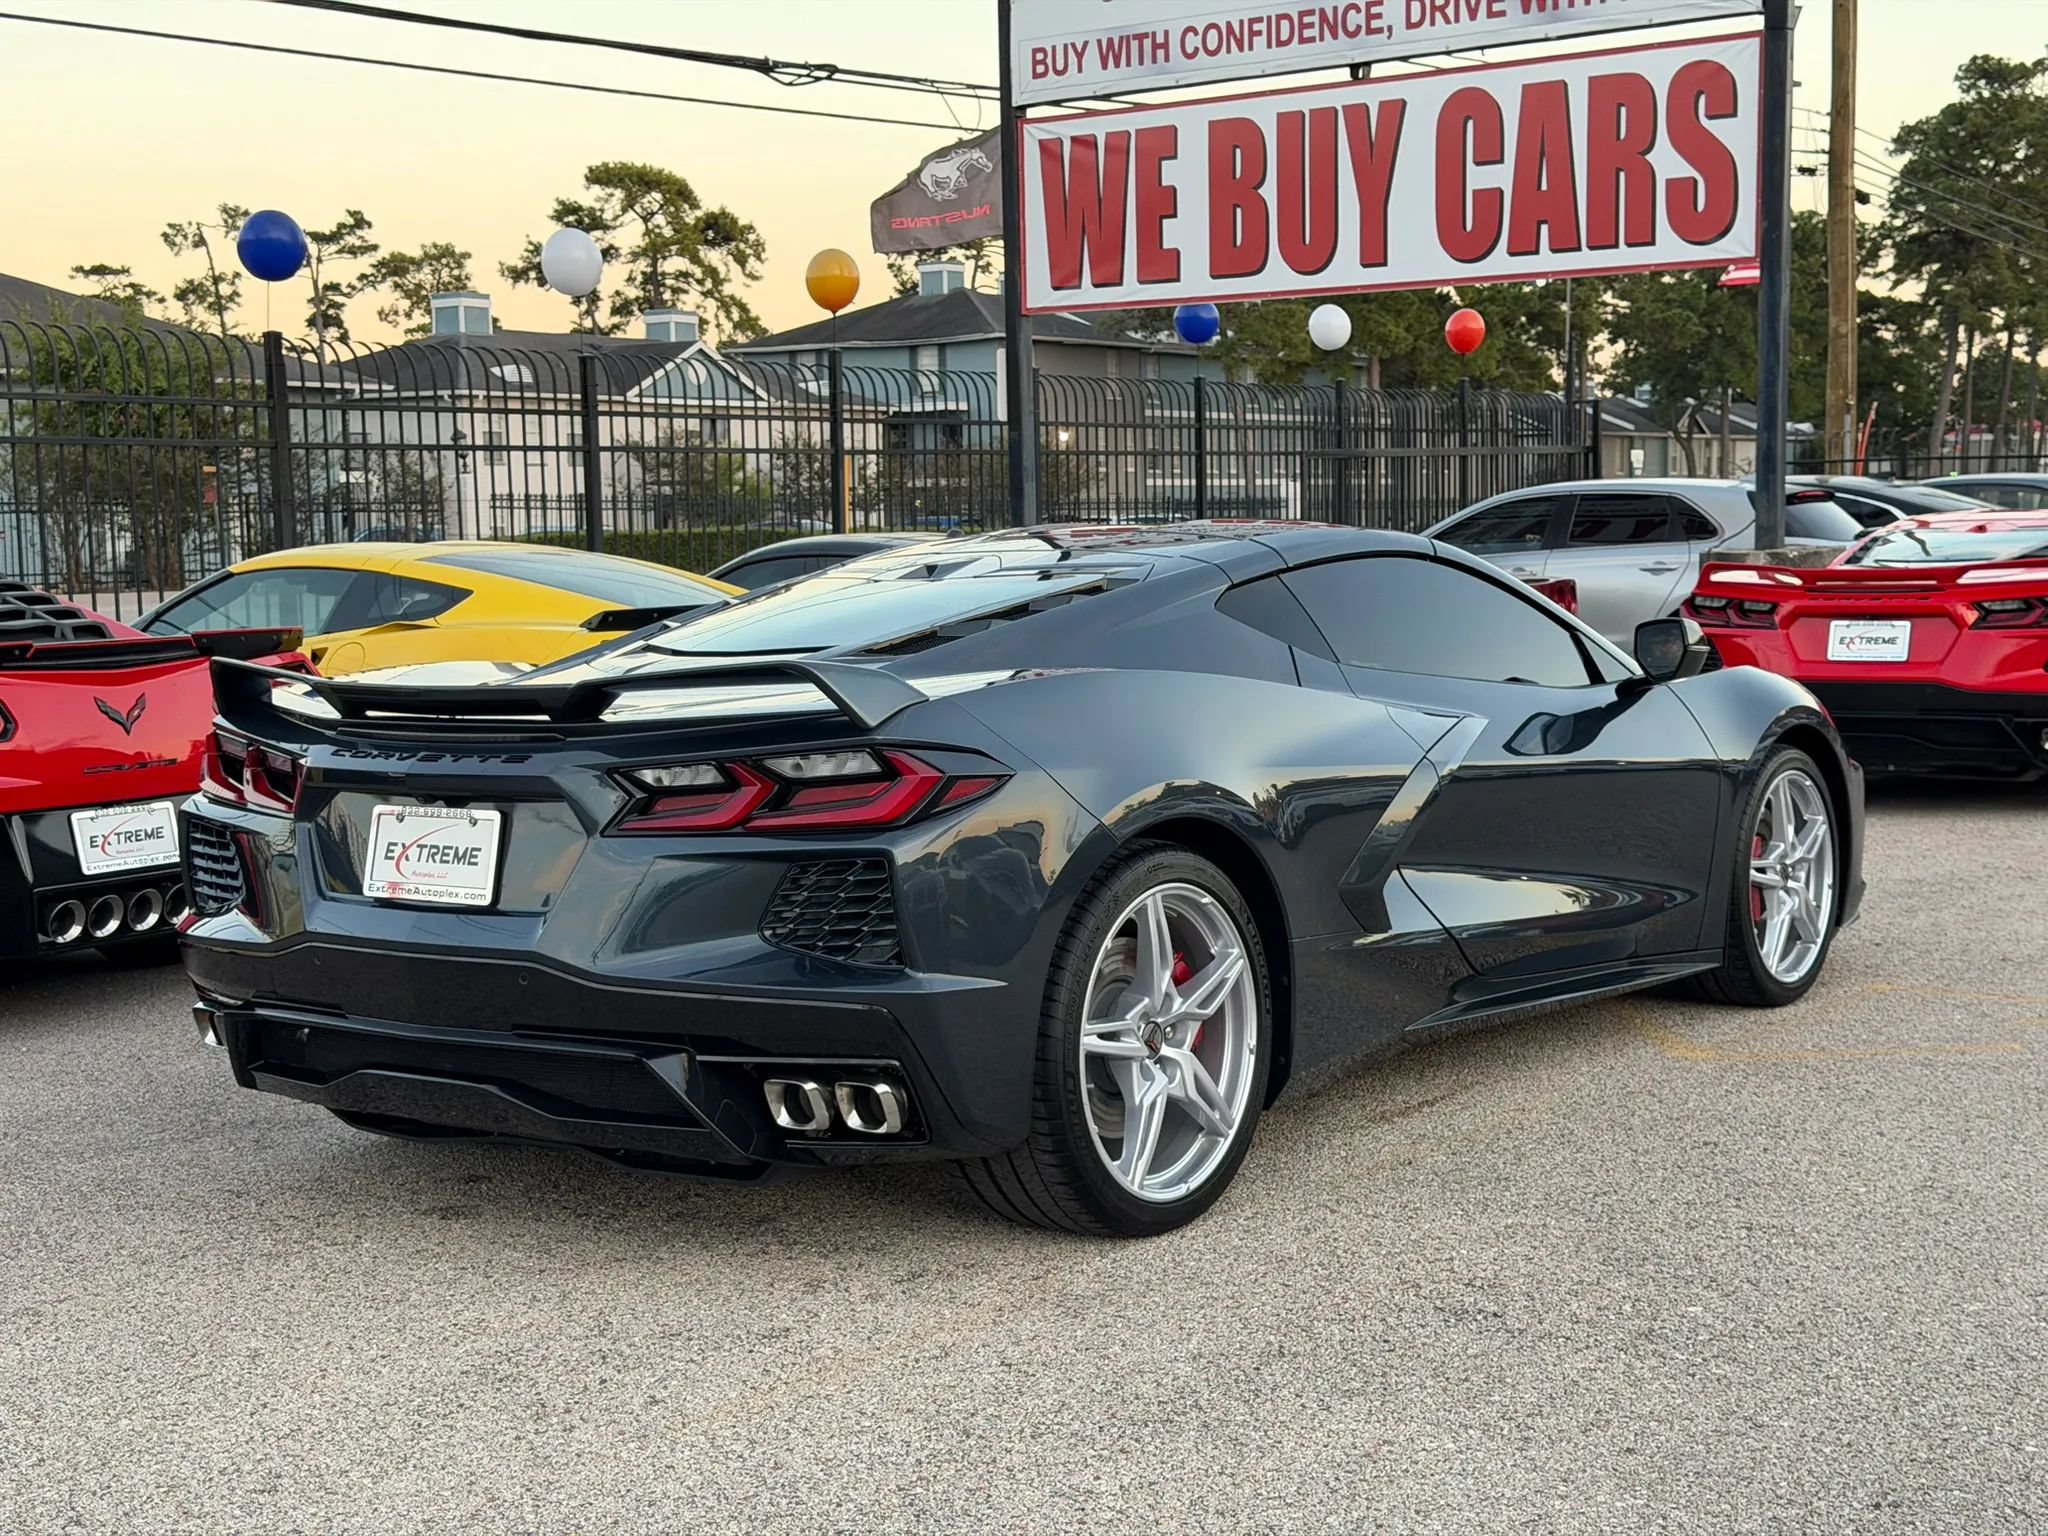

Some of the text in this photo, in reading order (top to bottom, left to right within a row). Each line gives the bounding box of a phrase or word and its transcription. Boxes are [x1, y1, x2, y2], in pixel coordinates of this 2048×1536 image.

[1031, 0, 1506, 80] BUY WITH CONFIDENCE, DRIVE
[1038, 59, 1739, 291] WE BUY CARS
[330, 747, 533, 765] CORVETTE
[89, 826, 165, 849] EXTREME
[384, 841, 482, 867] EXTREME
[368, 882, 487, 901] ExtremeAutoplex.com
